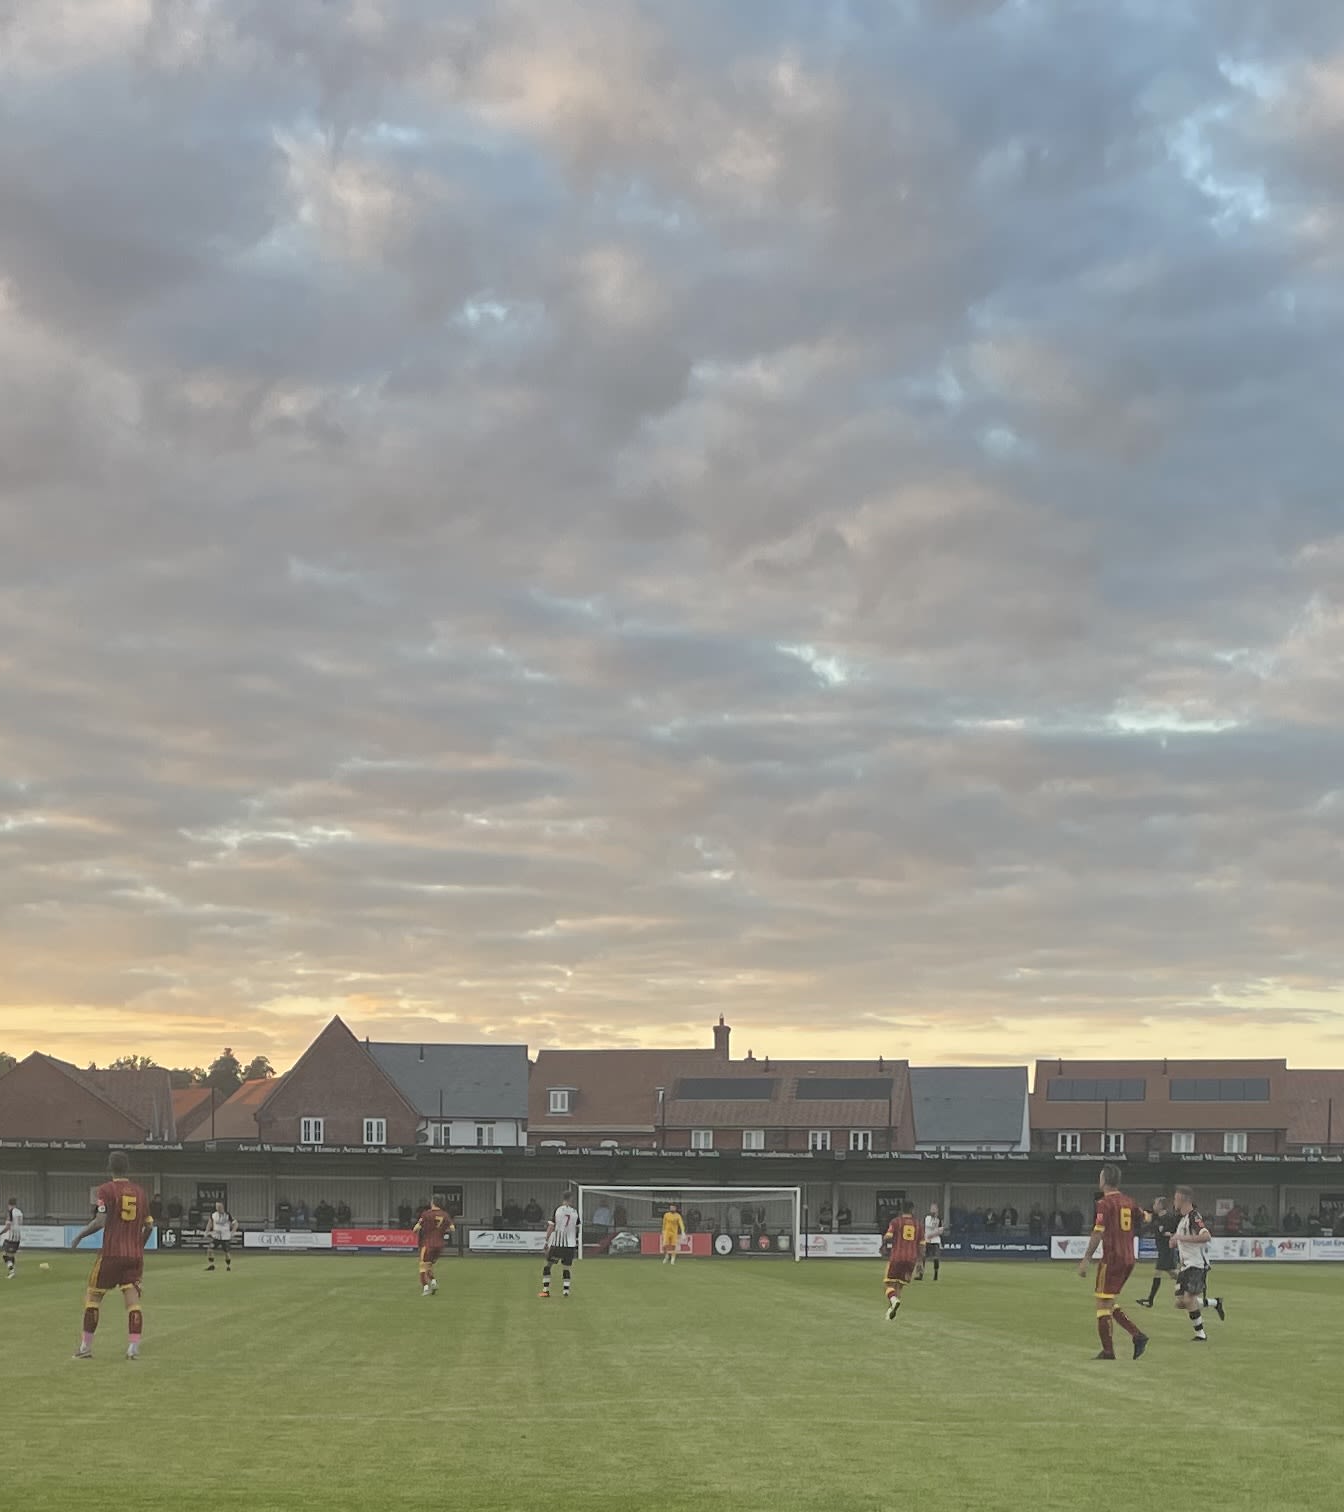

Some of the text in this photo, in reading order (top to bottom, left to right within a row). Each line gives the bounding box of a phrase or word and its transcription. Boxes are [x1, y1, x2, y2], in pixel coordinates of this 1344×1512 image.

[120, 1195, 137, 1222] 5
[434, 1216, 444, 1228] 7
[564, 1214, 571, 1228] 7
[1120, 1207, 1132, 1232] 6
[260, 1234, 286, 1244] GDM
[902, 1224, 916, 1241] 8
